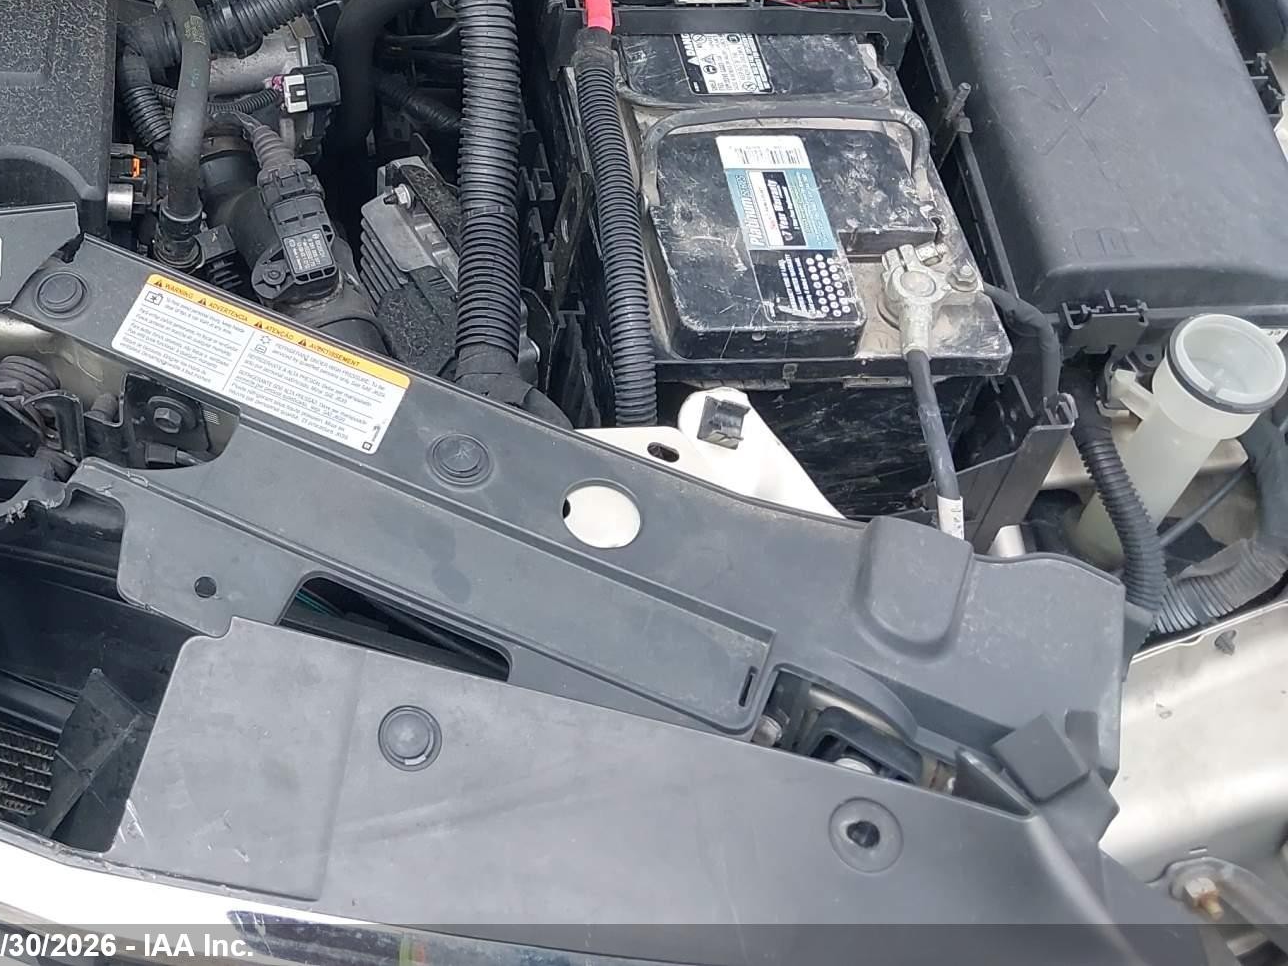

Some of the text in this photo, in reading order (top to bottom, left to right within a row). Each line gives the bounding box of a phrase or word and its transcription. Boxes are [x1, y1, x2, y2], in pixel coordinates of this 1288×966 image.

[680, 34, 696, 57] DANG
[767, 179, 784, 212] Warranty
[742, 197, 765, 247] Platinum
[778, 212, 789, 229] Year
[165, 282, 194, 299] WARNING
[209, 301, 249, 323] ADVERTENCIA
